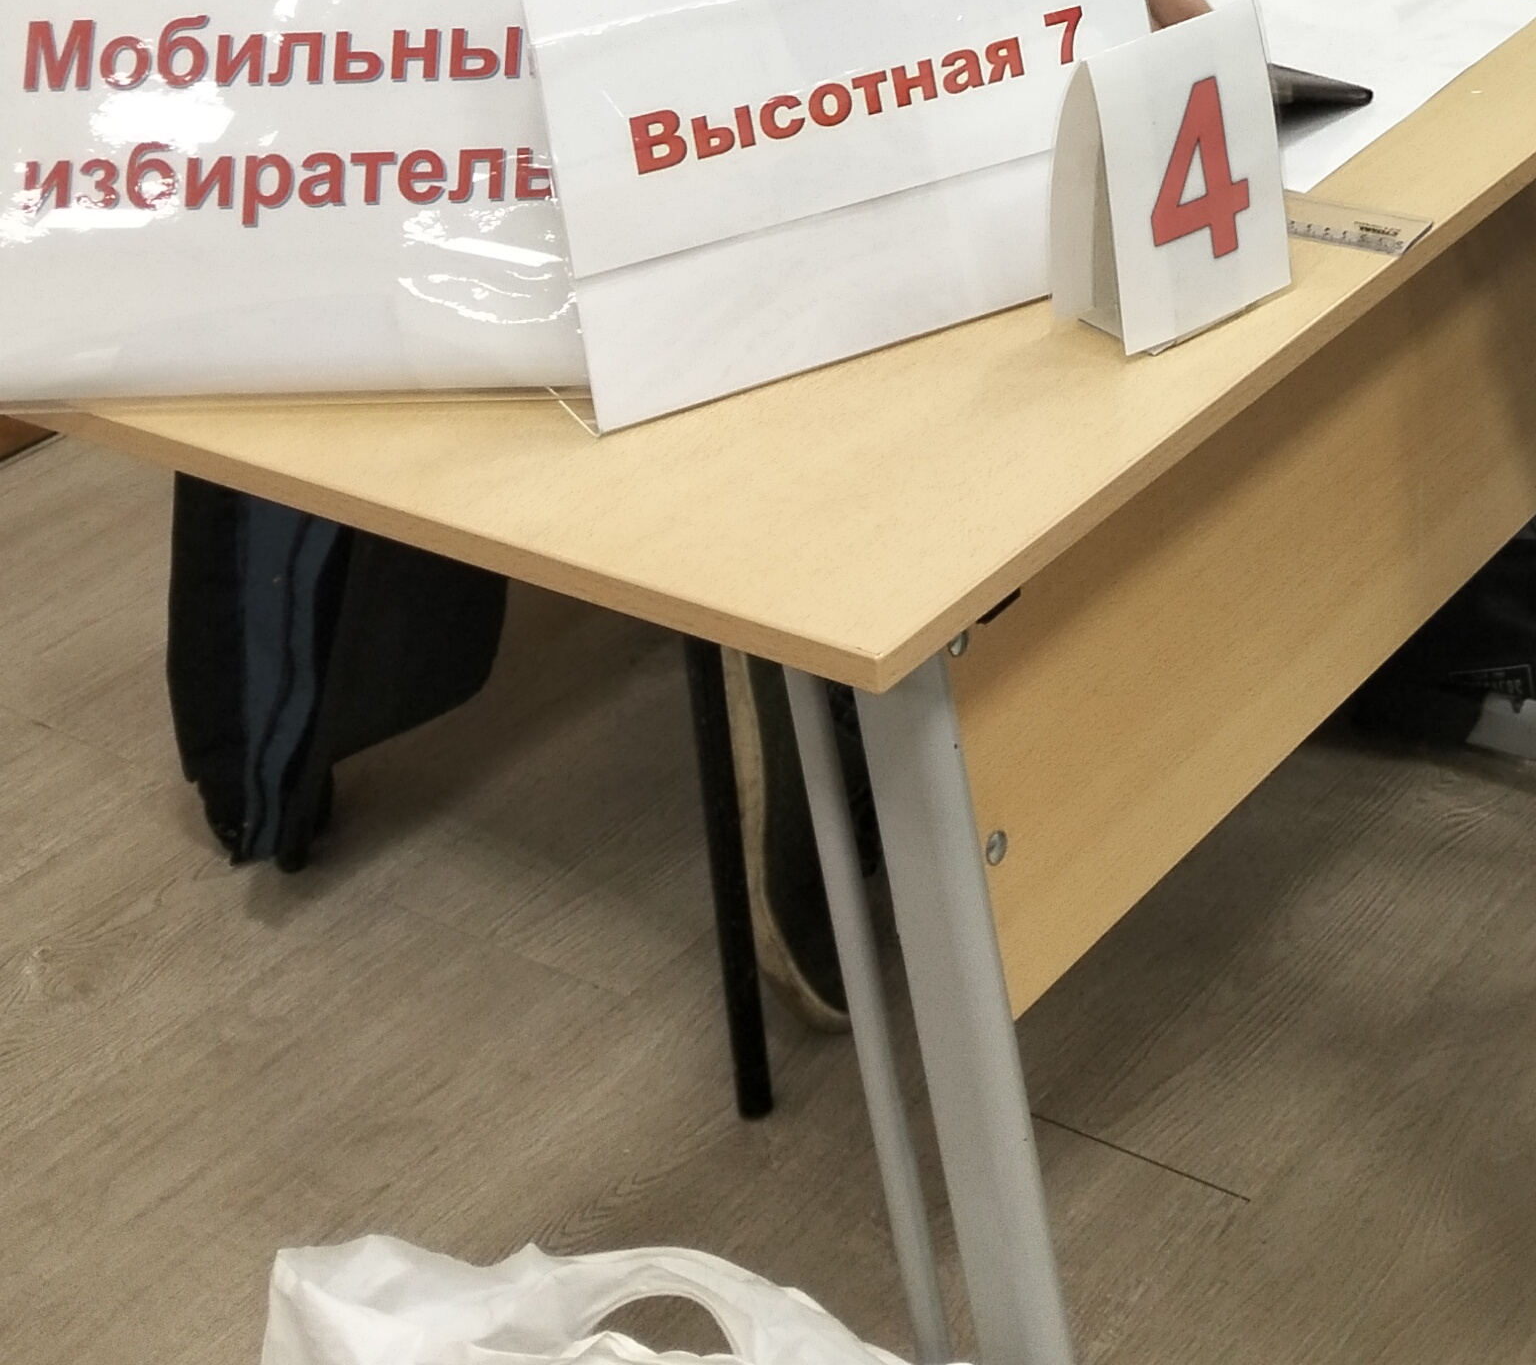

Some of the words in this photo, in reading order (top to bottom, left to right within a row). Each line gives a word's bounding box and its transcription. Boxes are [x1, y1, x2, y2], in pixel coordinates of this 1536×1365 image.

[628, 34, 1026, 176] Высотная
[1043, 5, 1084, 66] 7
[1149, 74, 1251, 259] 4
